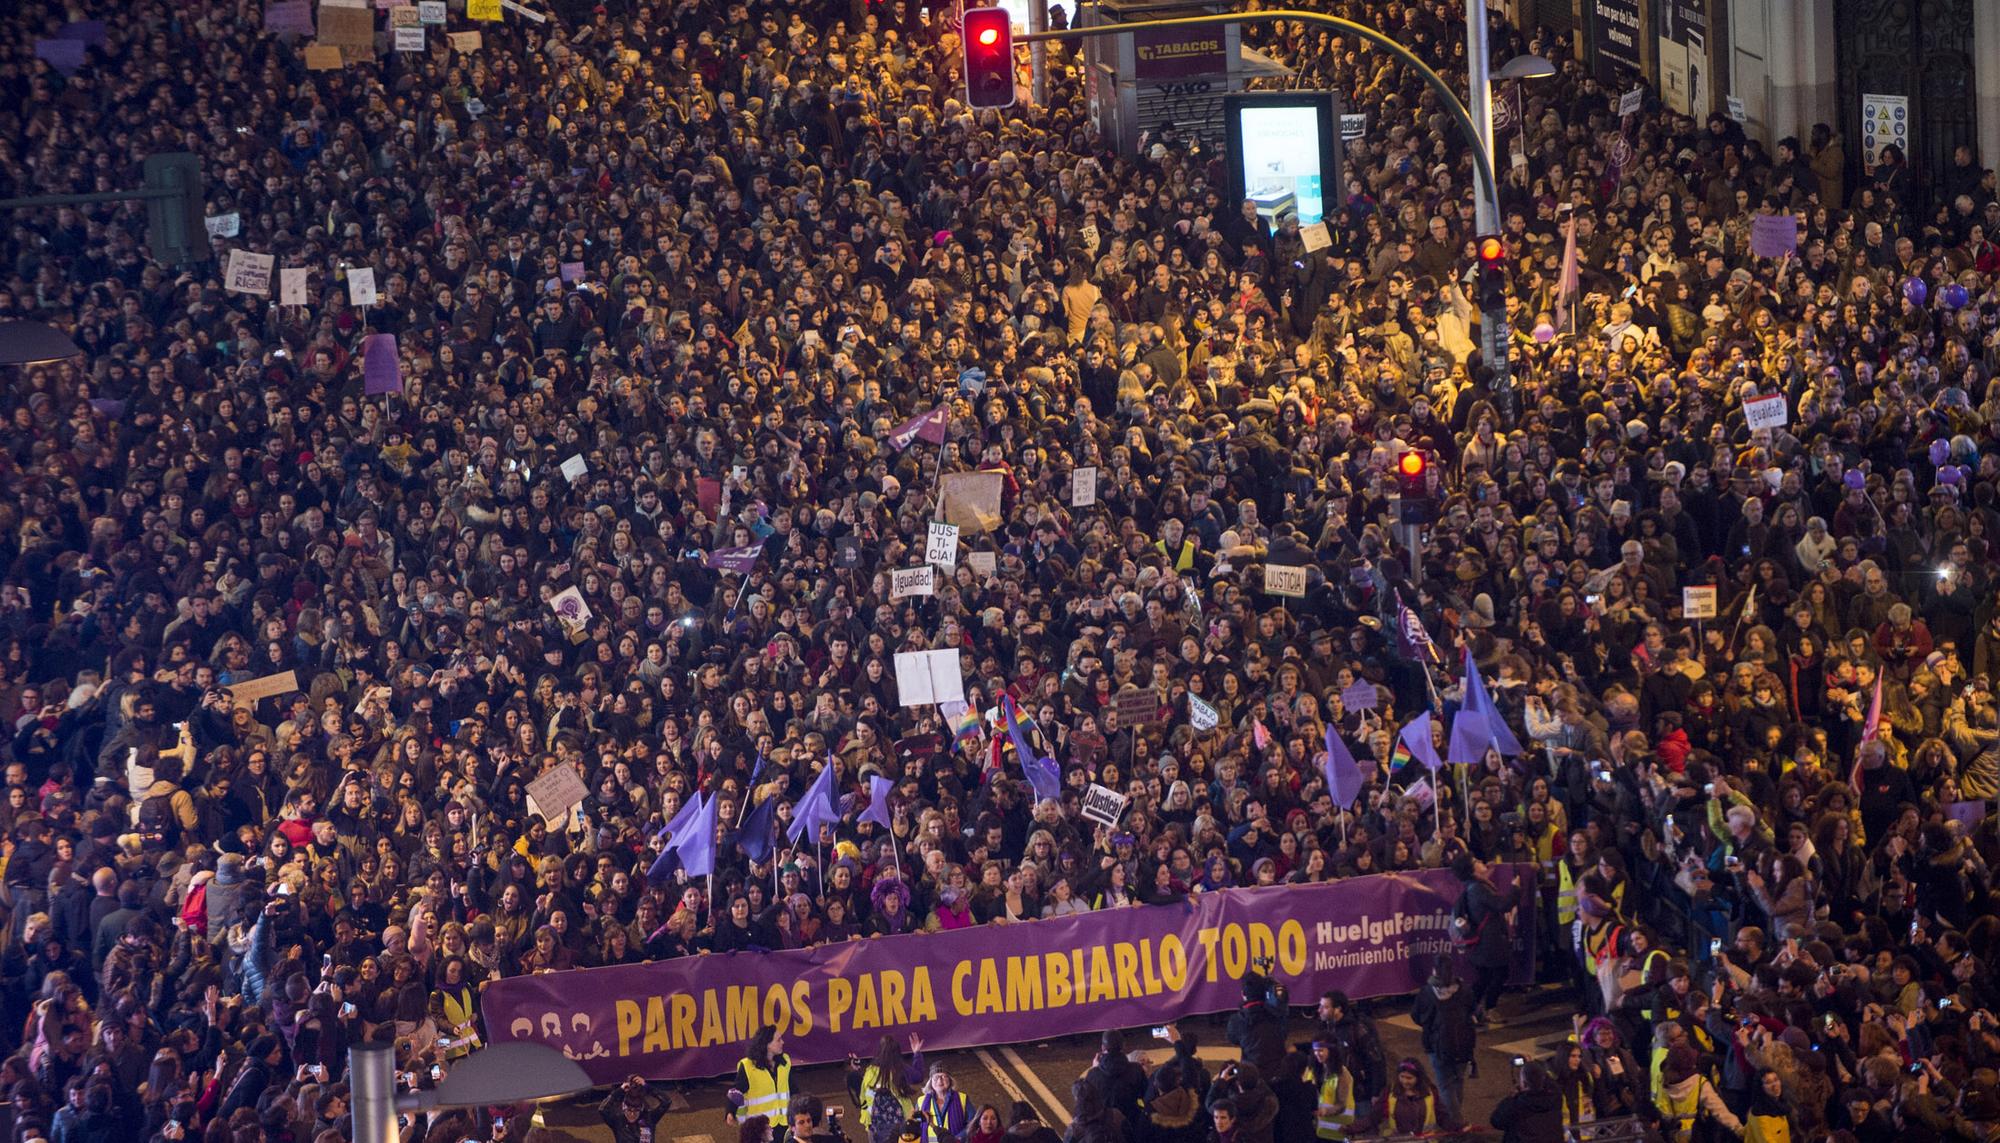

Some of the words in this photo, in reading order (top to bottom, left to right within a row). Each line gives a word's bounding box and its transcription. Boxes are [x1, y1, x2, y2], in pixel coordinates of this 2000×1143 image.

[1626, 10, 1639, 29] Libro
[1608, 27, 1632, 47] volvemos
[1155, 40, 1218, 55] TABACOS
[1341, 118, 1365, 131] usticia!
[930, 525, 957, 537] JUS-
[936, 537, 949, 548] TI-
[929, 549, 952, 561] CIA!
[1085, 789, 1123, 818] ¡Justicia!
[1315, 946, 1394, 971] Movimiento
[1397, 937, 1451, 959] Feminista
[615, 980, 814, 1057] PARAMOS
[828, 966, 938, 1034] PARA
[951, 933, 1187, 1017] CAMBIARLO
[1197, 919, 1307, 984] TODO
